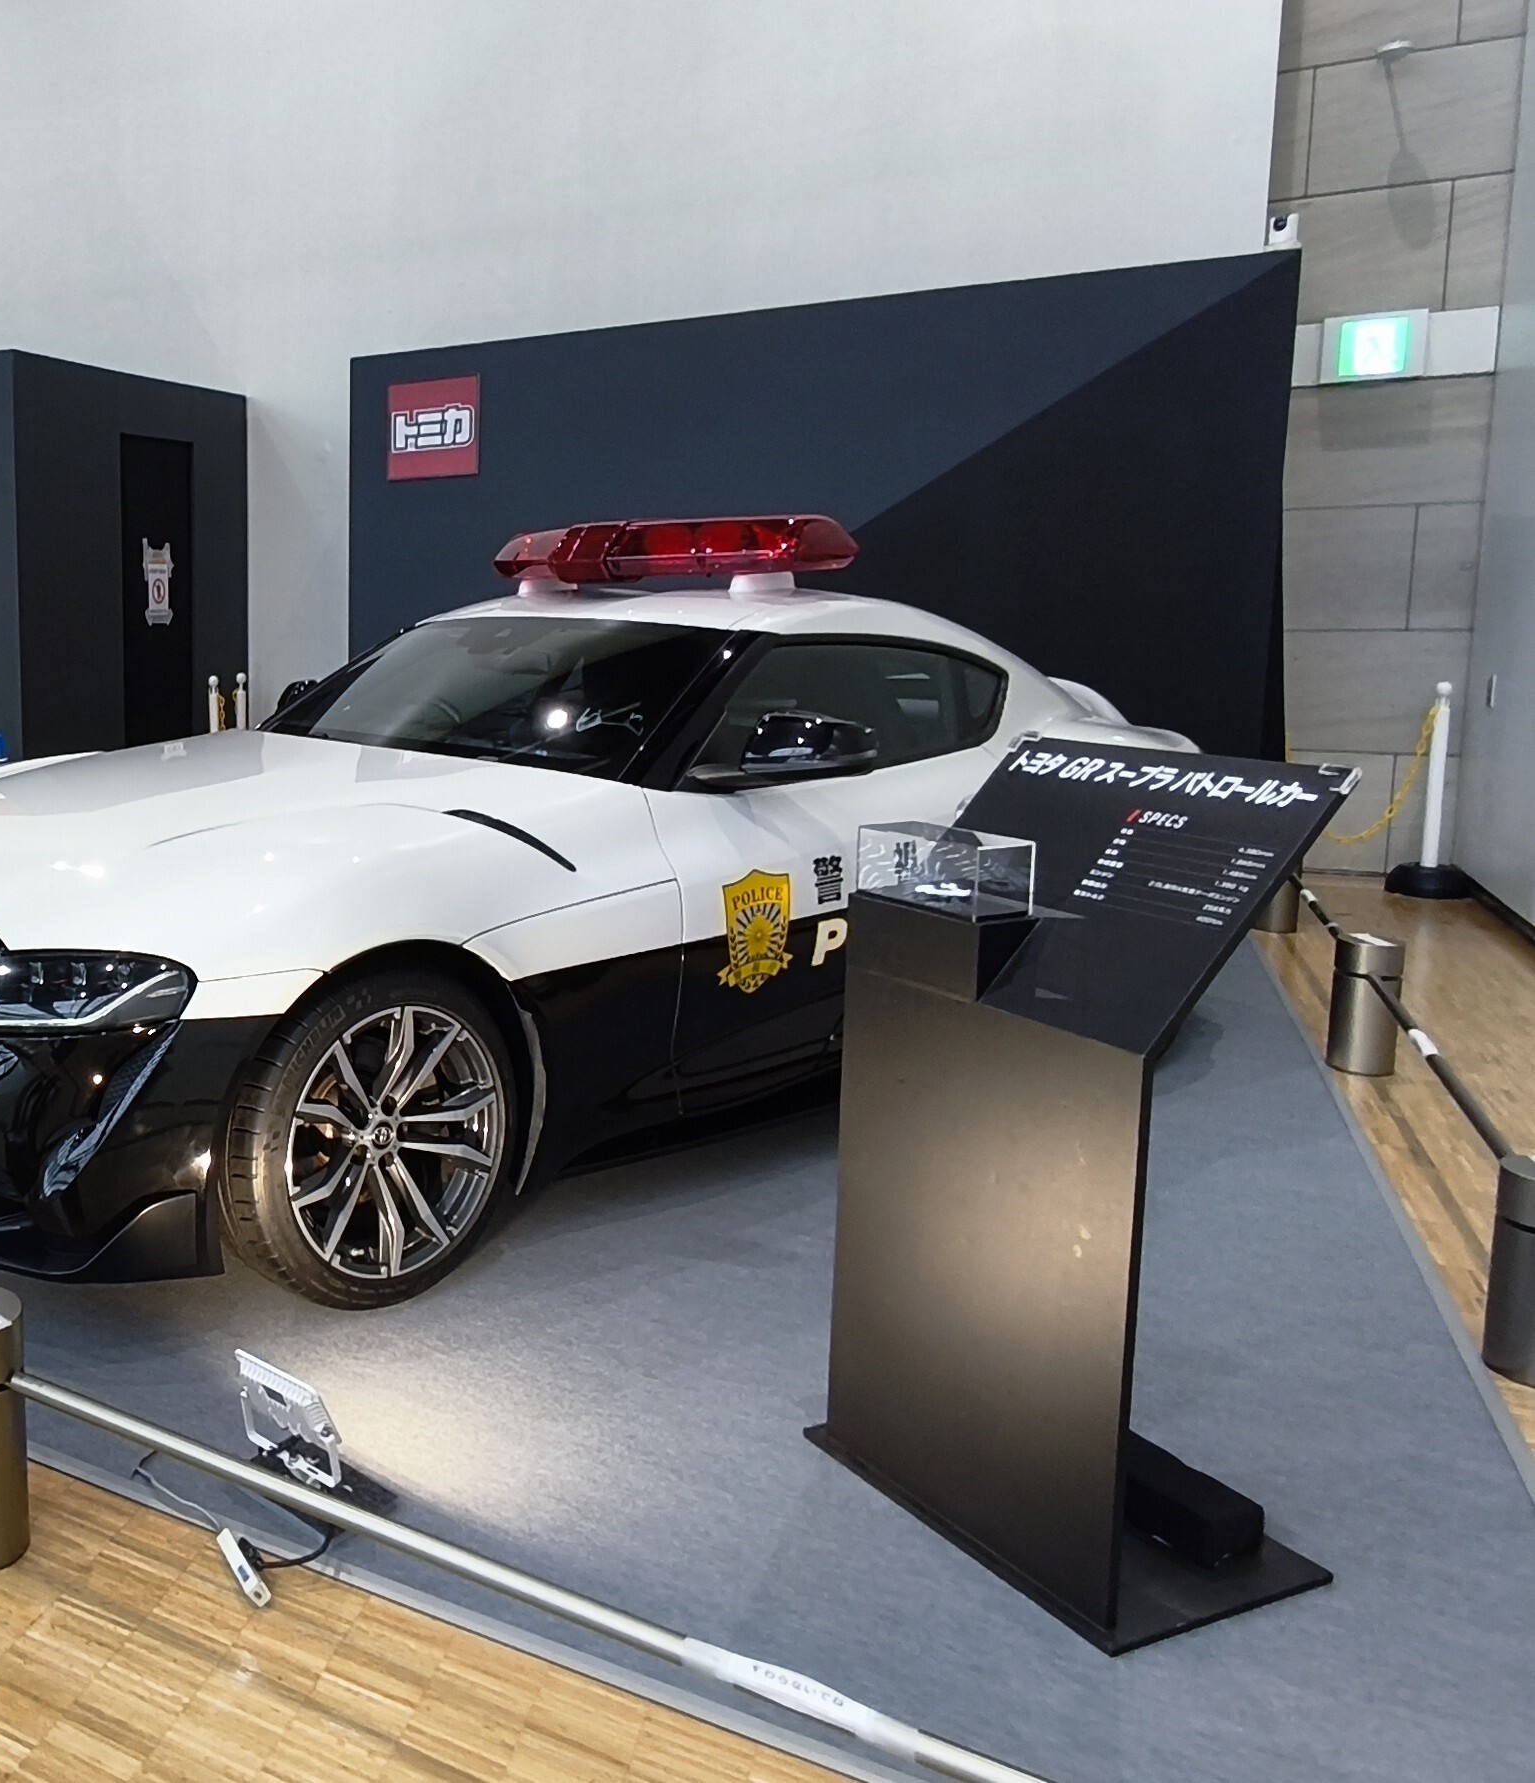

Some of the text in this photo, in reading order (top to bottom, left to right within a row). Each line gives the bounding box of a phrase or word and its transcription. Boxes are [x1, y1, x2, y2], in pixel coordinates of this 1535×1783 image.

[392, 402, 475, 454] トミカ
[1008, 750, 1319, 808] トヨタ GR スープラ パトロールカー
[1138, 810, 1188, 829] SPECS
[732, 886, 784, 911] POLICE
